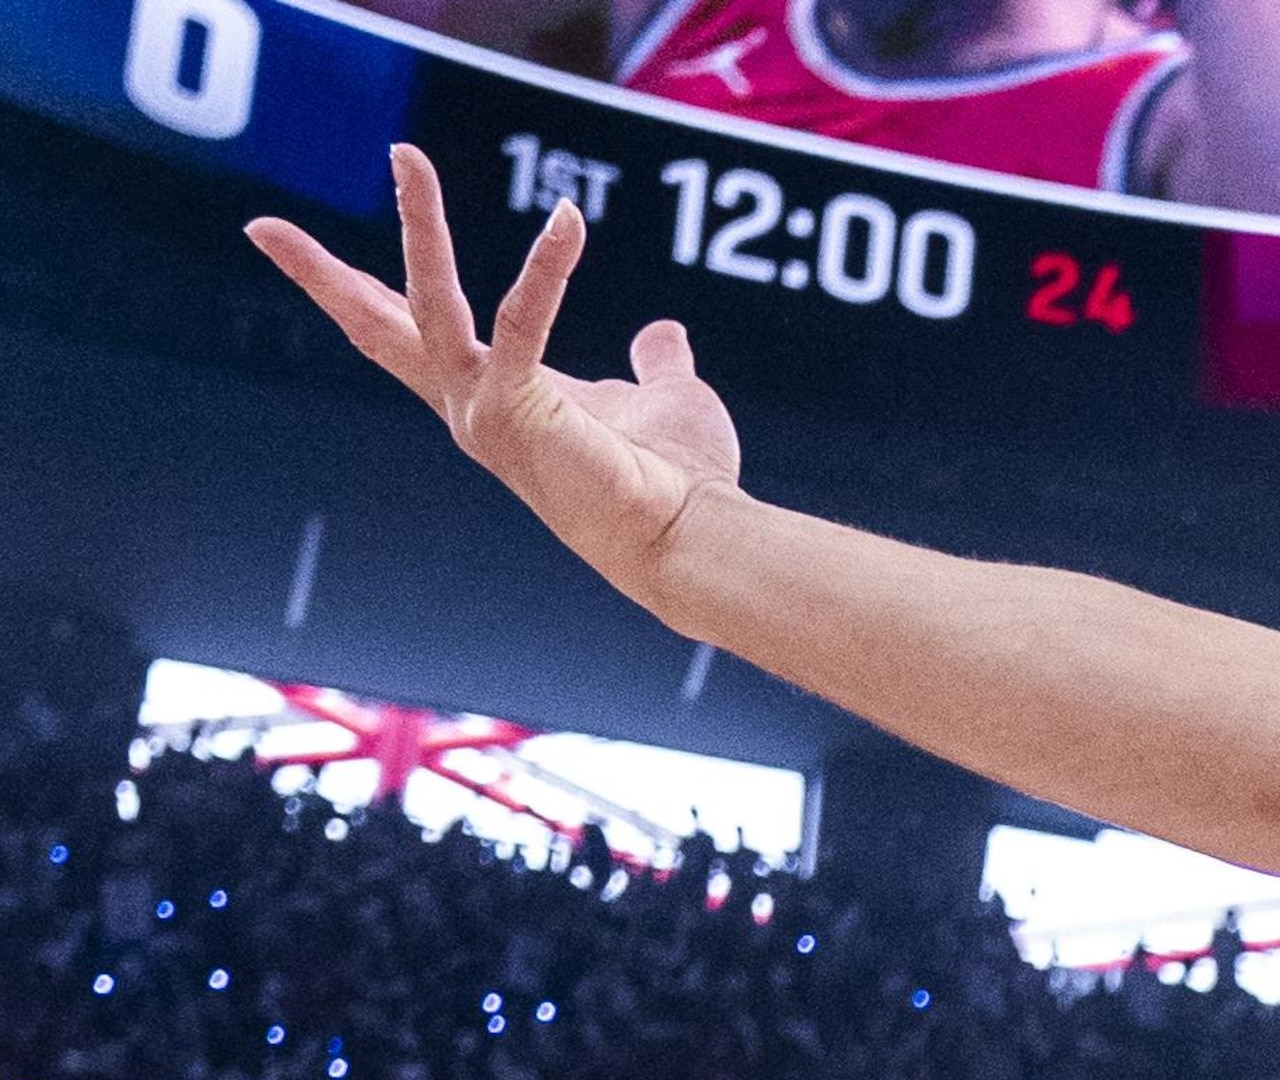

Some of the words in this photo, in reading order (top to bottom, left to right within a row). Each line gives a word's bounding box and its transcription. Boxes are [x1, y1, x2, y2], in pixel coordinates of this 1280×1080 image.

[122, 0, 262, 141] 0
[500, 132, 621, 223] 1ST
[661, 158, 977, 320] 12:00
[1025, 249, 1135, 334] 24
